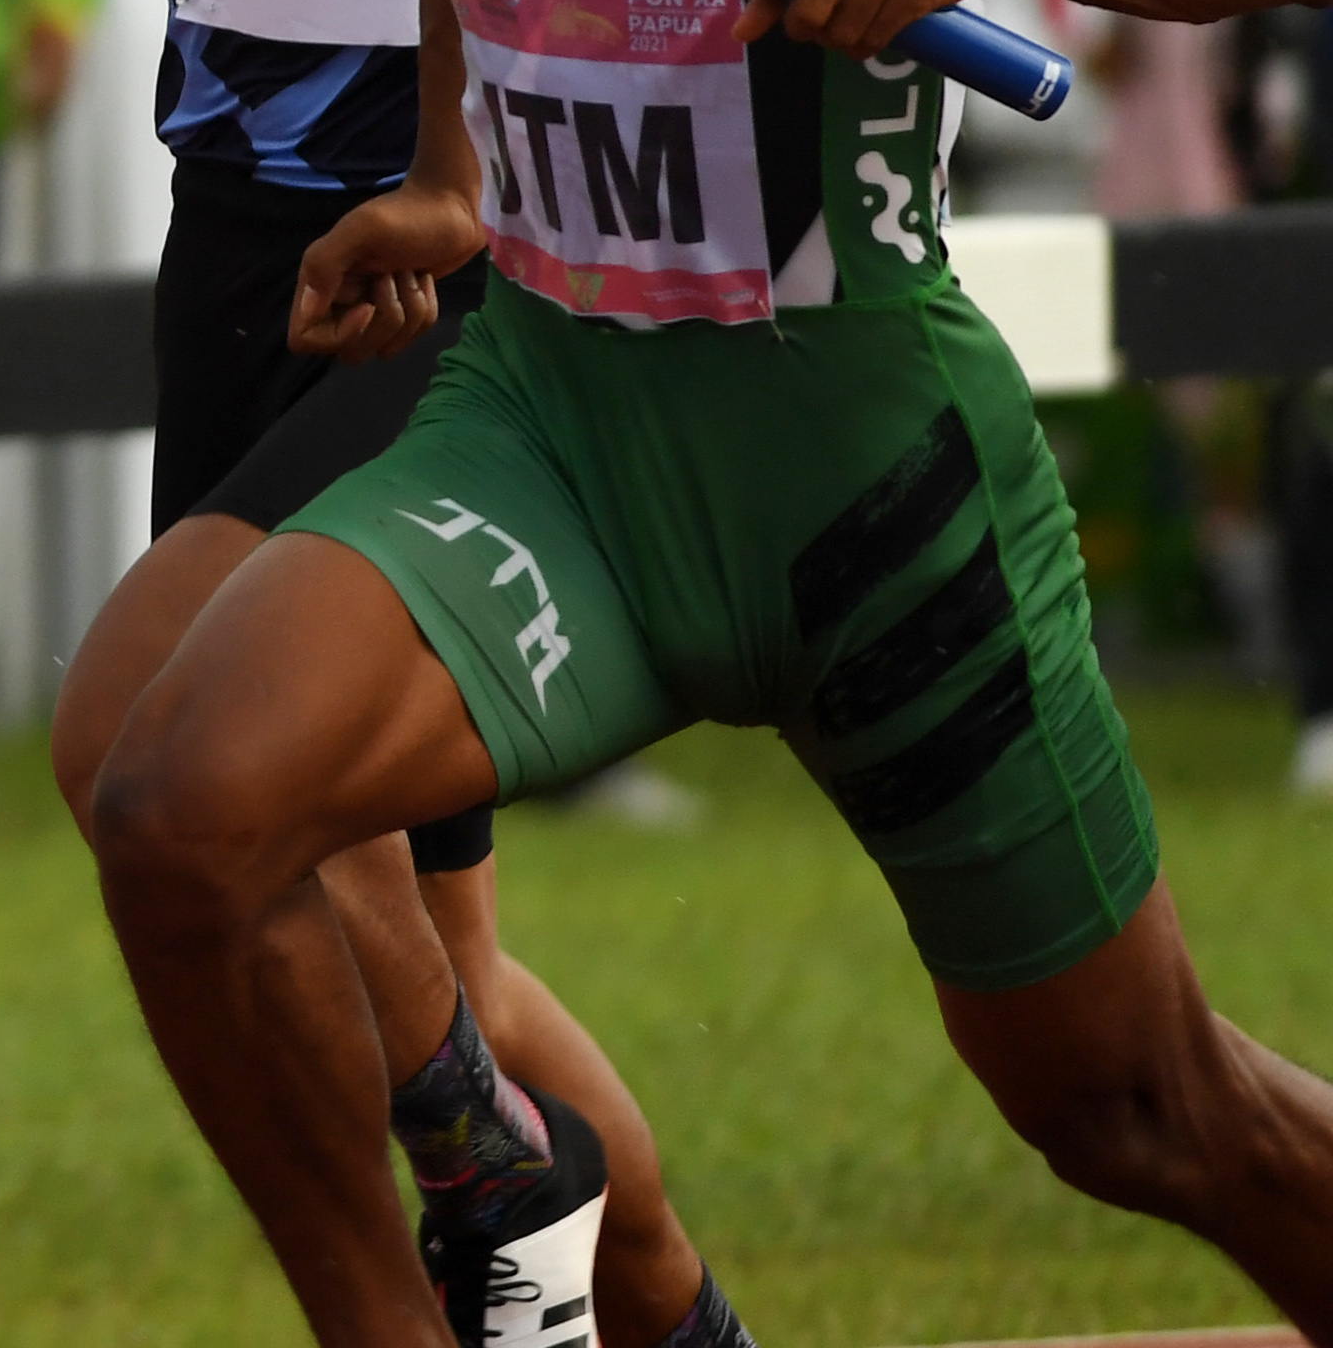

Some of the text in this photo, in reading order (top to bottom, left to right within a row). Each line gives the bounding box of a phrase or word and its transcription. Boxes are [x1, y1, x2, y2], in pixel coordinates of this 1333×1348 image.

[628, 14, 703, 35] PAPUA
[630, 35, 668, 51] 2021
[482, 80, 706, 244] JTM
[394, 497, 571, 717] JTM
